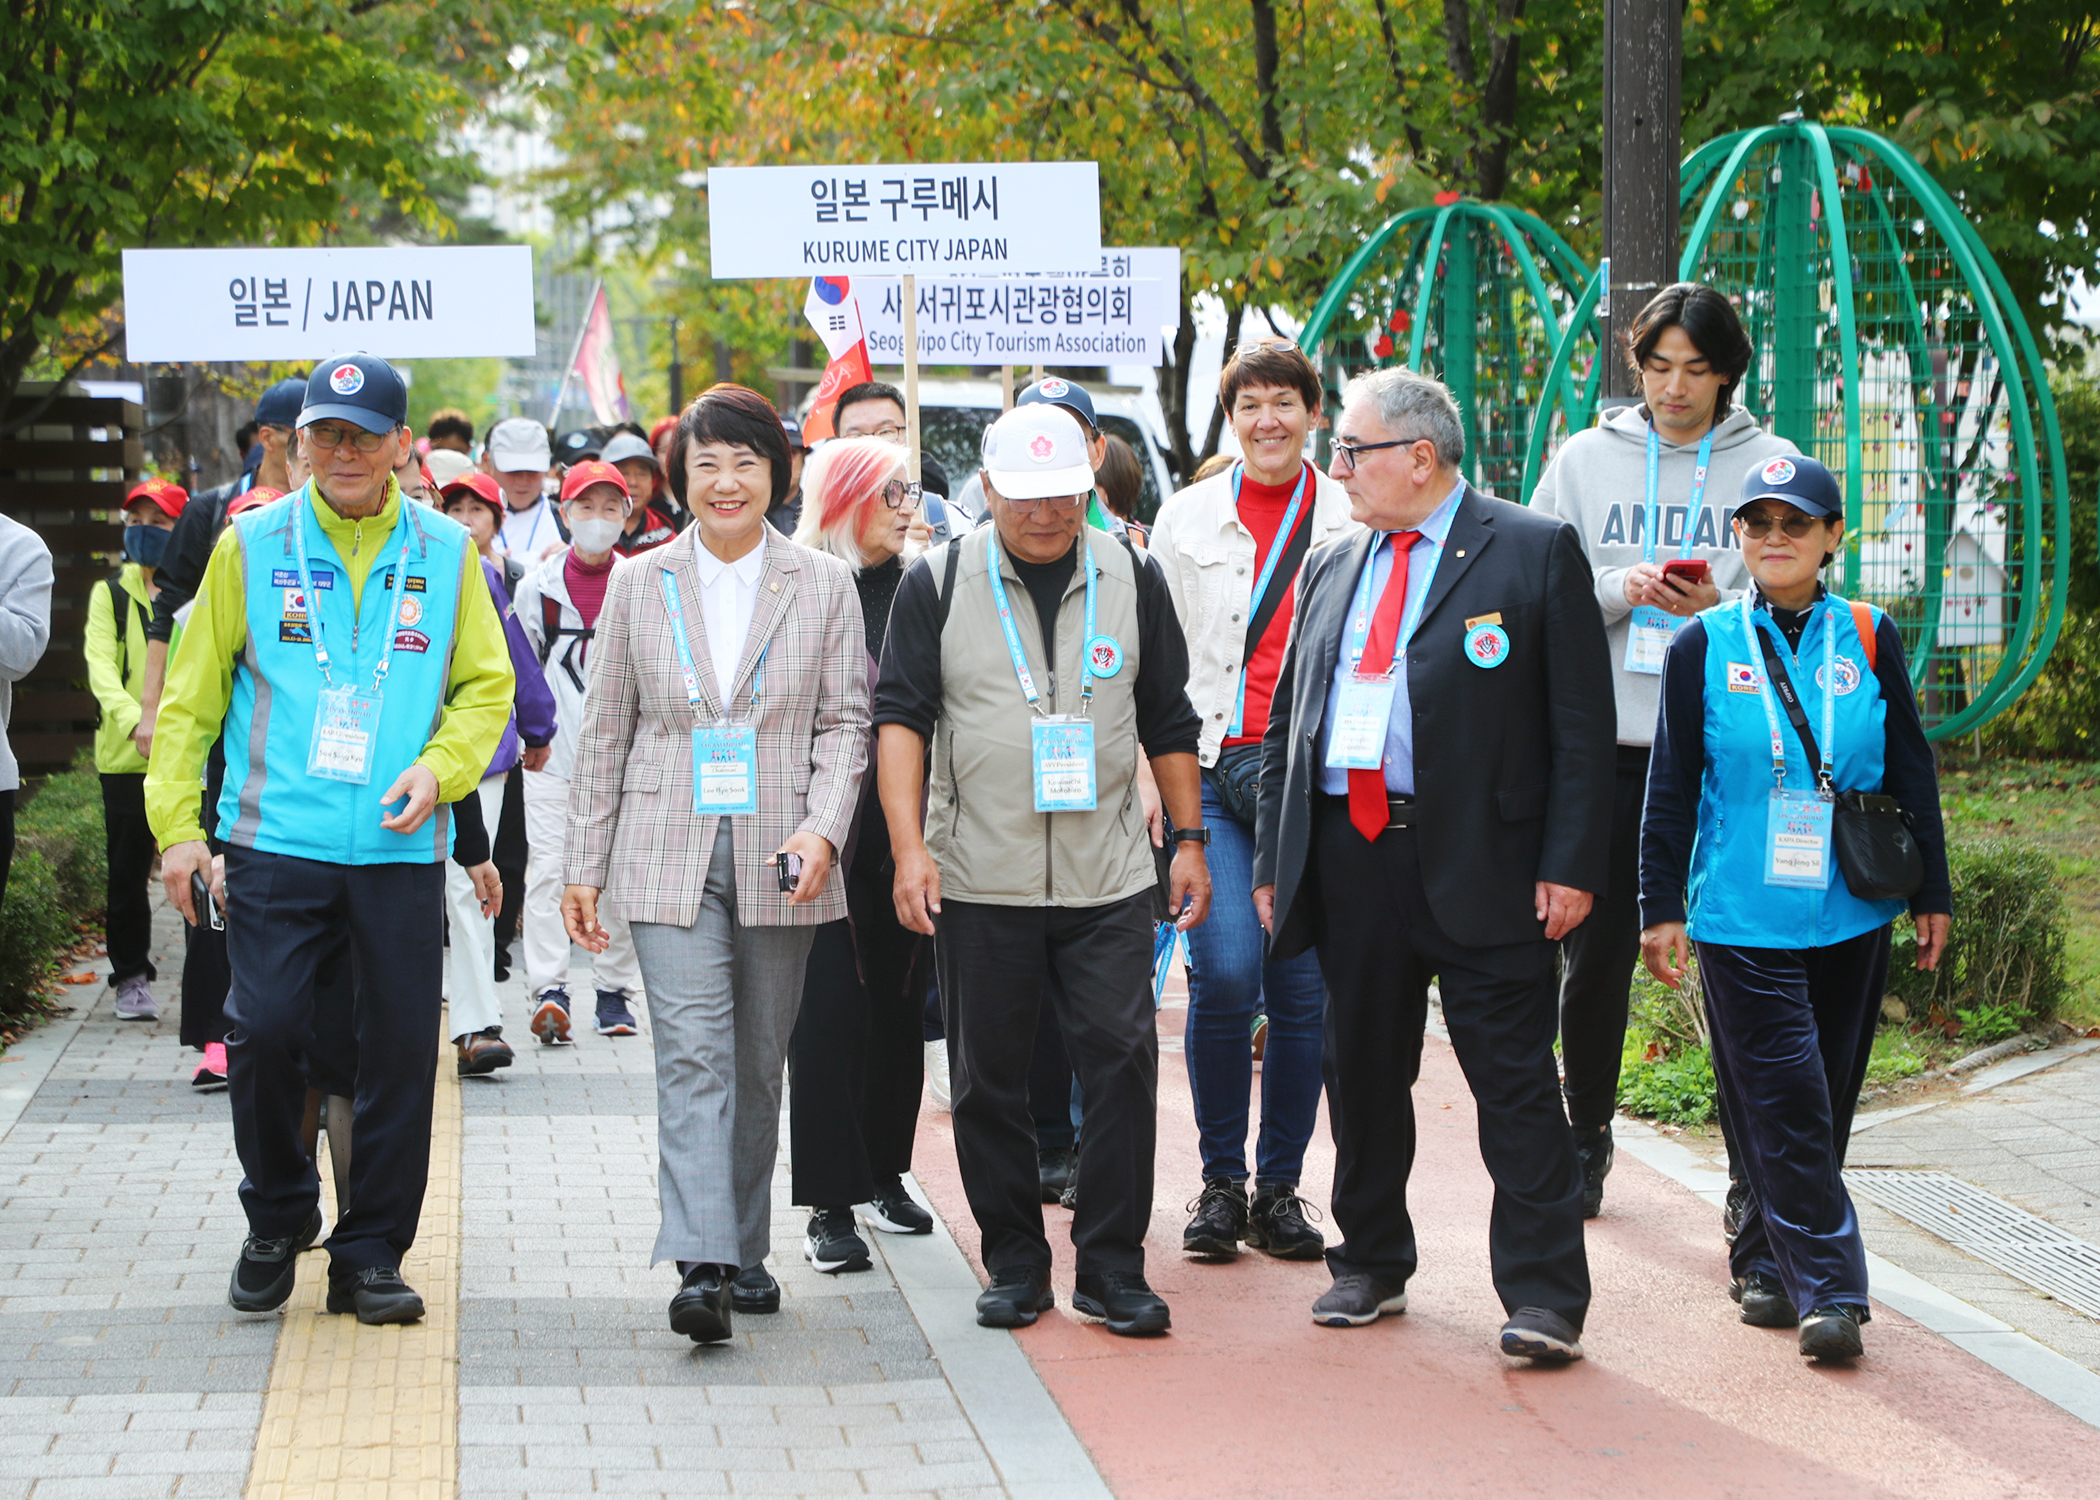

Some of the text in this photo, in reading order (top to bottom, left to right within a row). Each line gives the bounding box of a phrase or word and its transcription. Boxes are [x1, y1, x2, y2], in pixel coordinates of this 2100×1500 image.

[810, 175, 999, 223] 일본 구루메시
[803, 237, 1008, 264] KURUME CITY JAPAN
[228, 276, 433, 332] 일본 / JAPAN
[950, 330, 981, 357] City
[985, 330, 1051, 352] Tourism
[1055, 331, 1146, 353] Association
[1278, 521, 1290, 539] KOREA
[393, 576, 402, 595] KOREA
[1421, 568, 1433, 586] KOREA
[297, 546, 309, 590] INTERNATIONAL
[310, 616, 320, 641] FESTIVAL
[1406, 585, 1426, 630] INTERNATIONAL
[674, 618, 684, 646] ASIANPIAD
[1004, 616, 1018, 646] ASIANPIAD
[1015, 654, 1023, 665] THE
[1775, 857, 1793, 866] Yang
